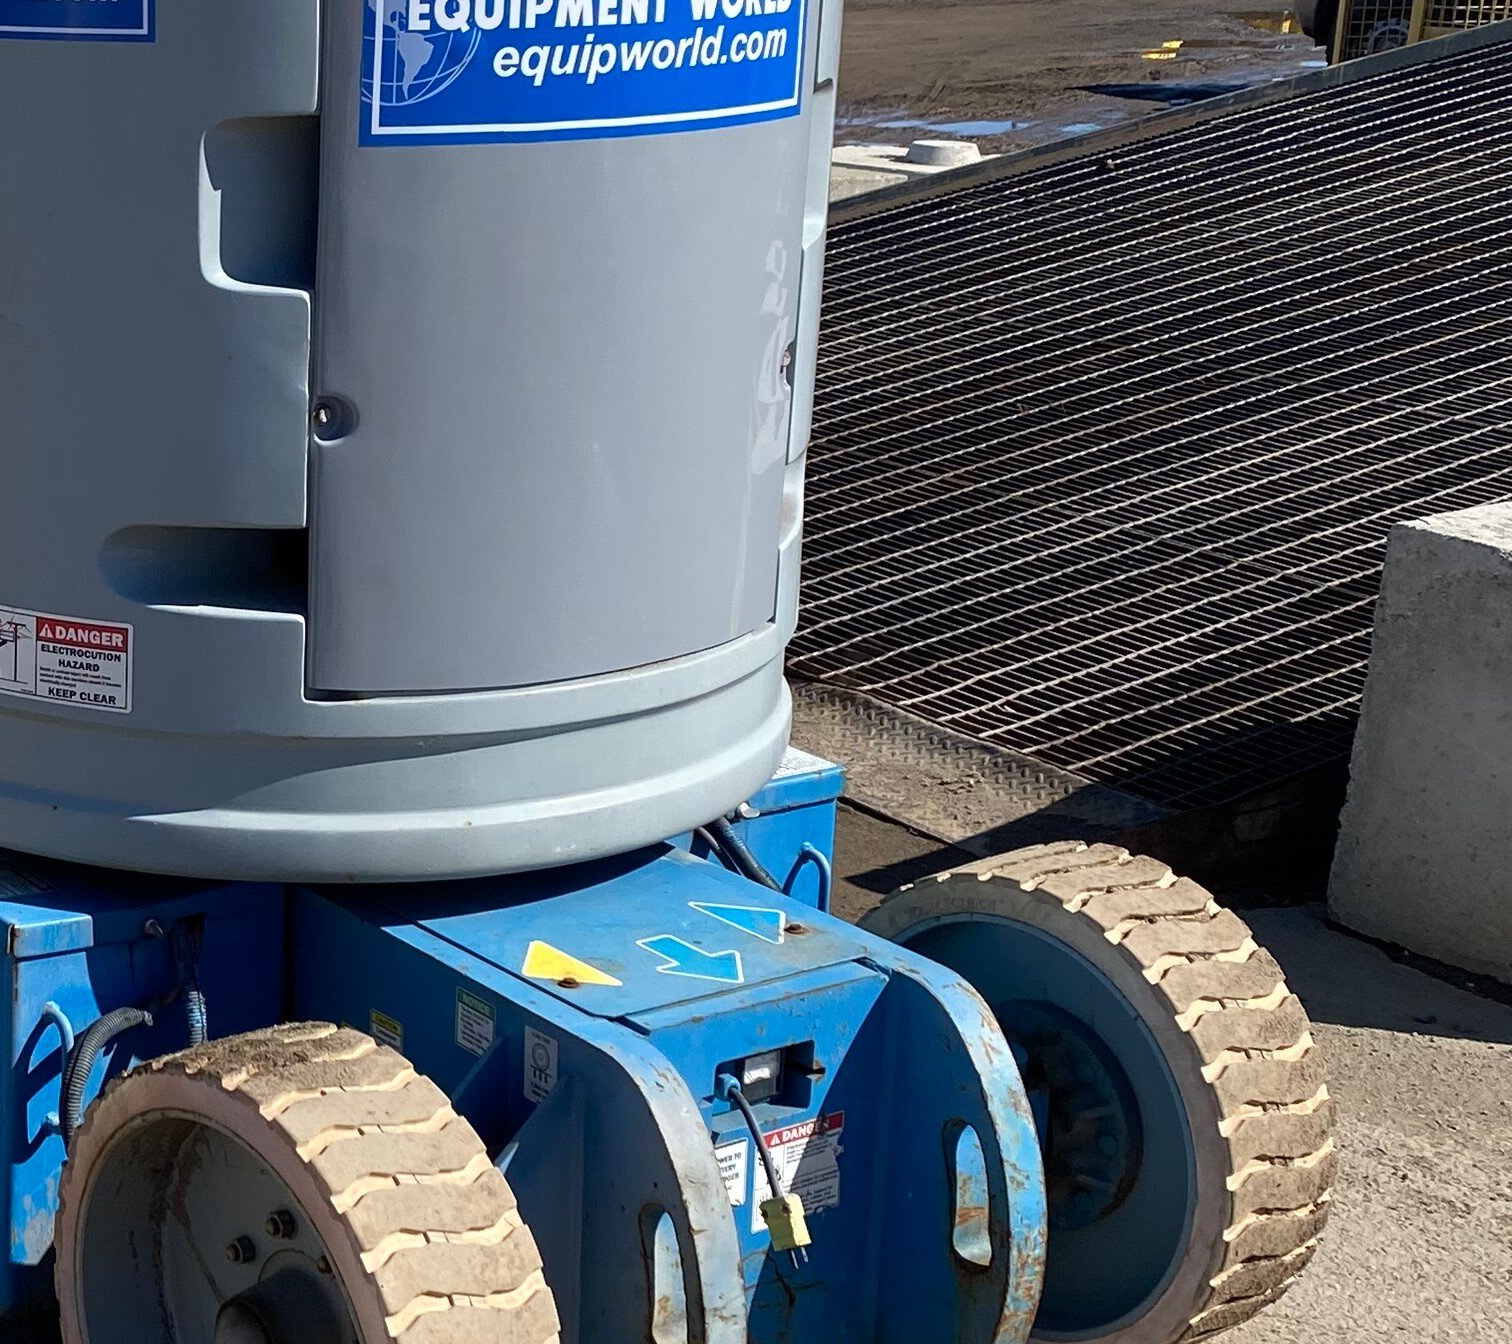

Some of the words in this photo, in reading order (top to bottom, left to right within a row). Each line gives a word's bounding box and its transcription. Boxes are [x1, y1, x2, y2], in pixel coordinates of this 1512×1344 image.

[492, 25, 788, 87] equipworld.com
[55, 625, 124, 648] DANGER
[40, 643, 122, 663] ELECTROCUTION
[58, 658, 100, 672] HAZARD
[48, 686, 77, 699] KEEP
[79, 691, 117, 706] CLEAR
